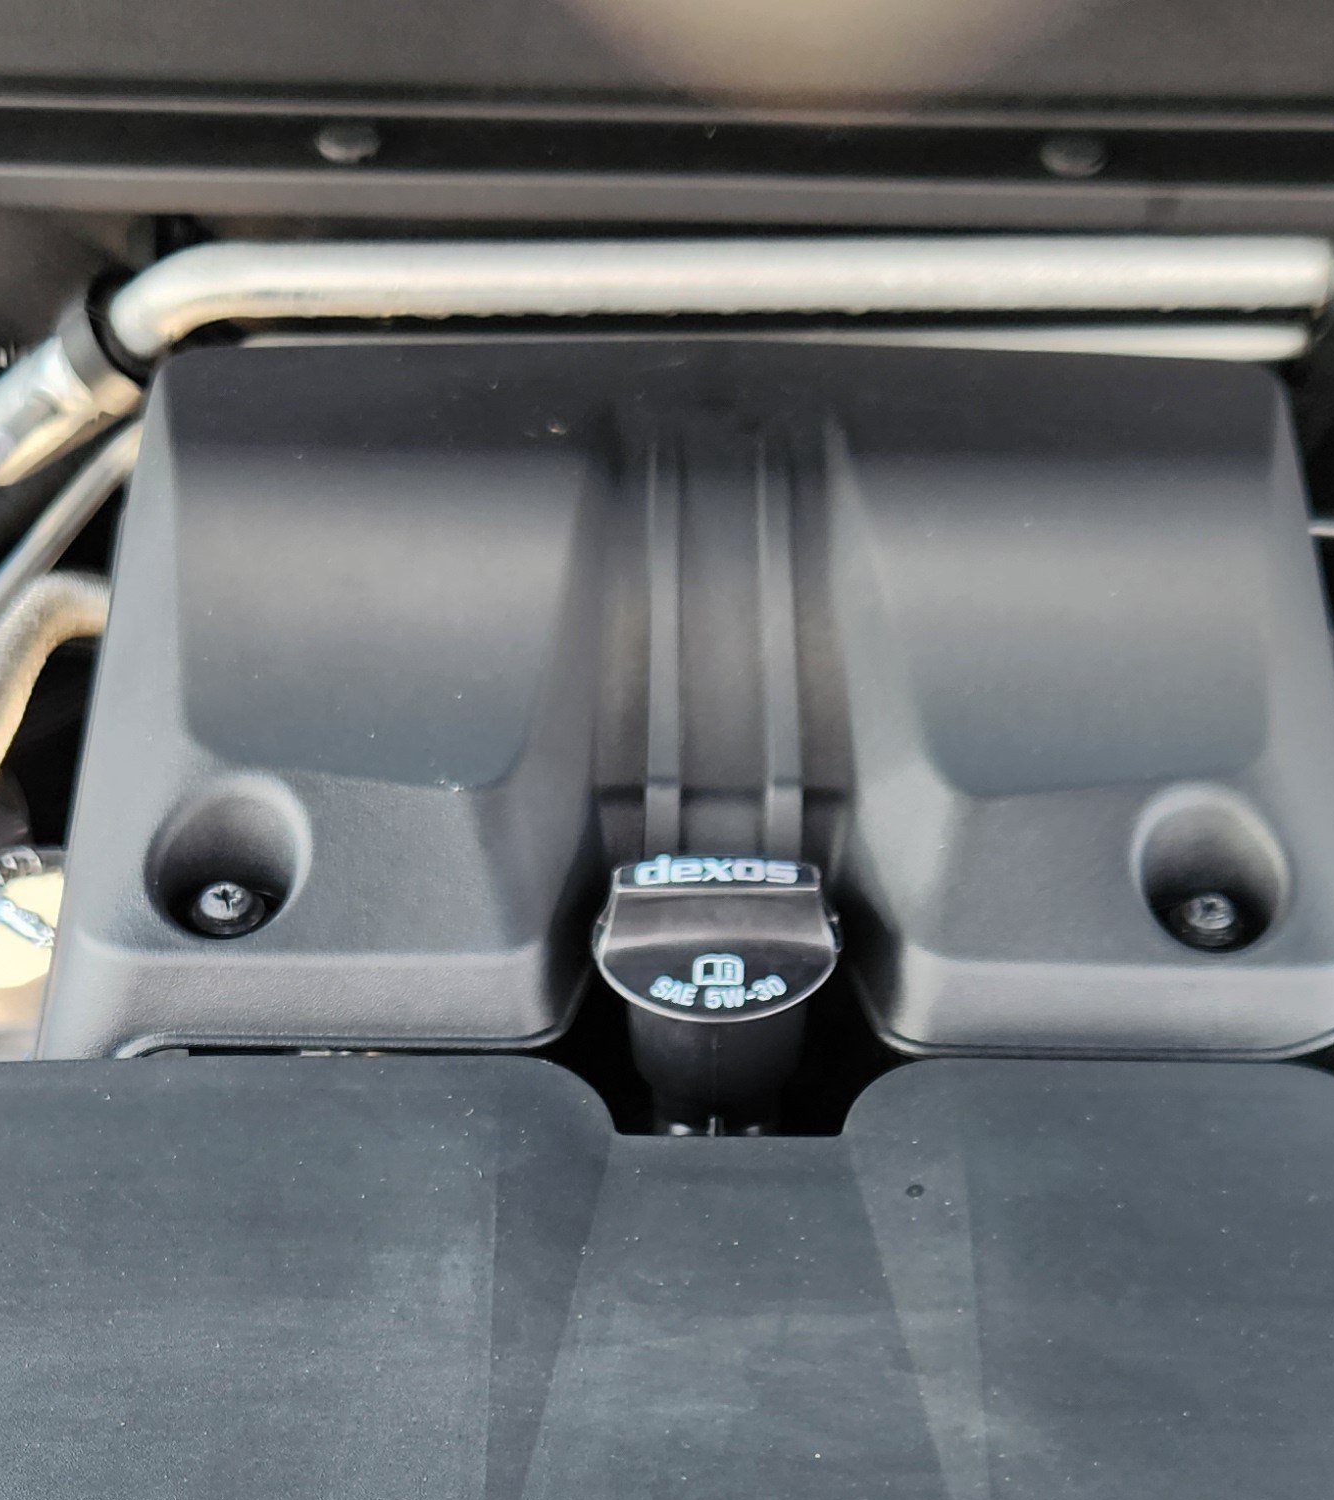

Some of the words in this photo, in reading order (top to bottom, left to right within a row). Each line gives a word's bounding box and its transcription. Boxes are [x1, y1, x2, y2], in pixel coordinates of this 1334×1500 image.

[634, 854, 799, 886] dexos
[649, 975, 699, 1007] SAE
[704, 974, 788, 1009] 5W-30
